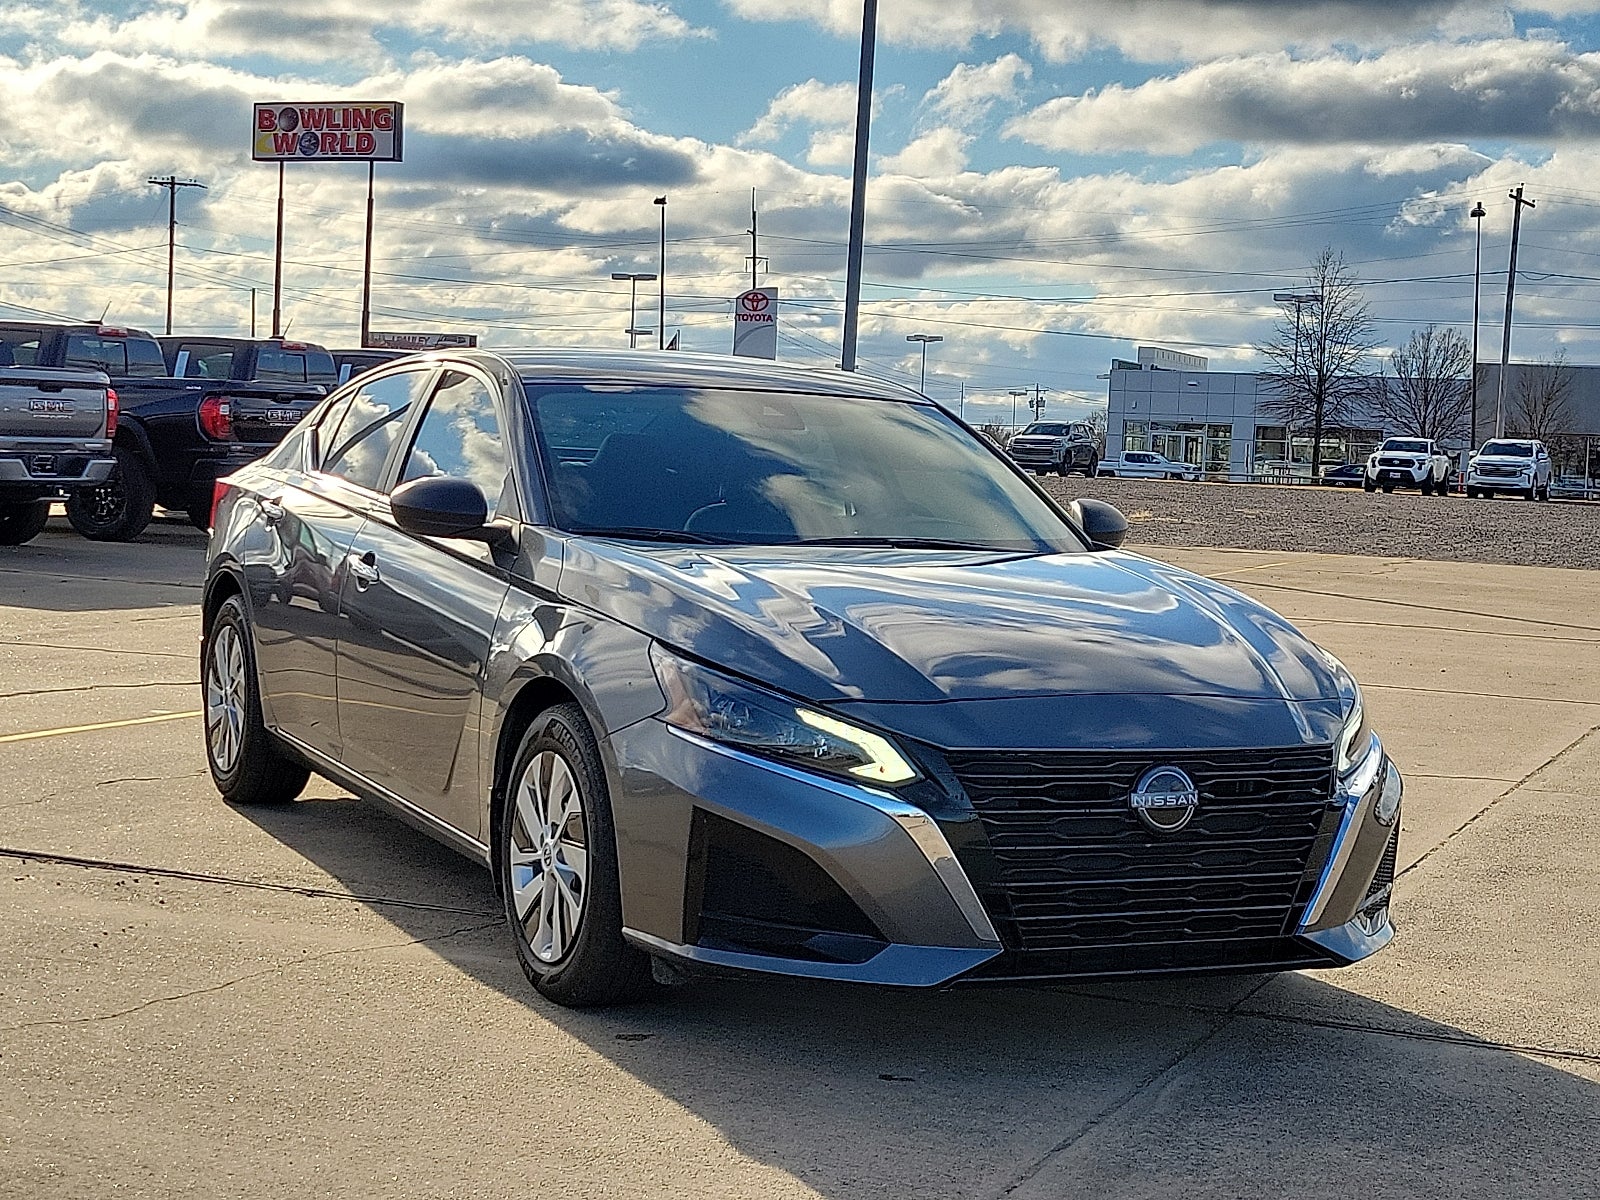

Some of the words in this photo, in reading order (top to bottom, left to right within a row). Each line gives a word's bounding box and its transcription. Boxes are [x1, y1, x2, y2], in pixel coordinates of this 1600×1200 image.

[258, 107, 393, 131] BOWLING
[273, 132, 376, 155] WORLD
[735, 313, 774, 322] TOYOTA
[30, 400, 75, 412] GMC
[268, 409, 302, 421] GMC
[1134, 793, 1198, 806] NISSAN
